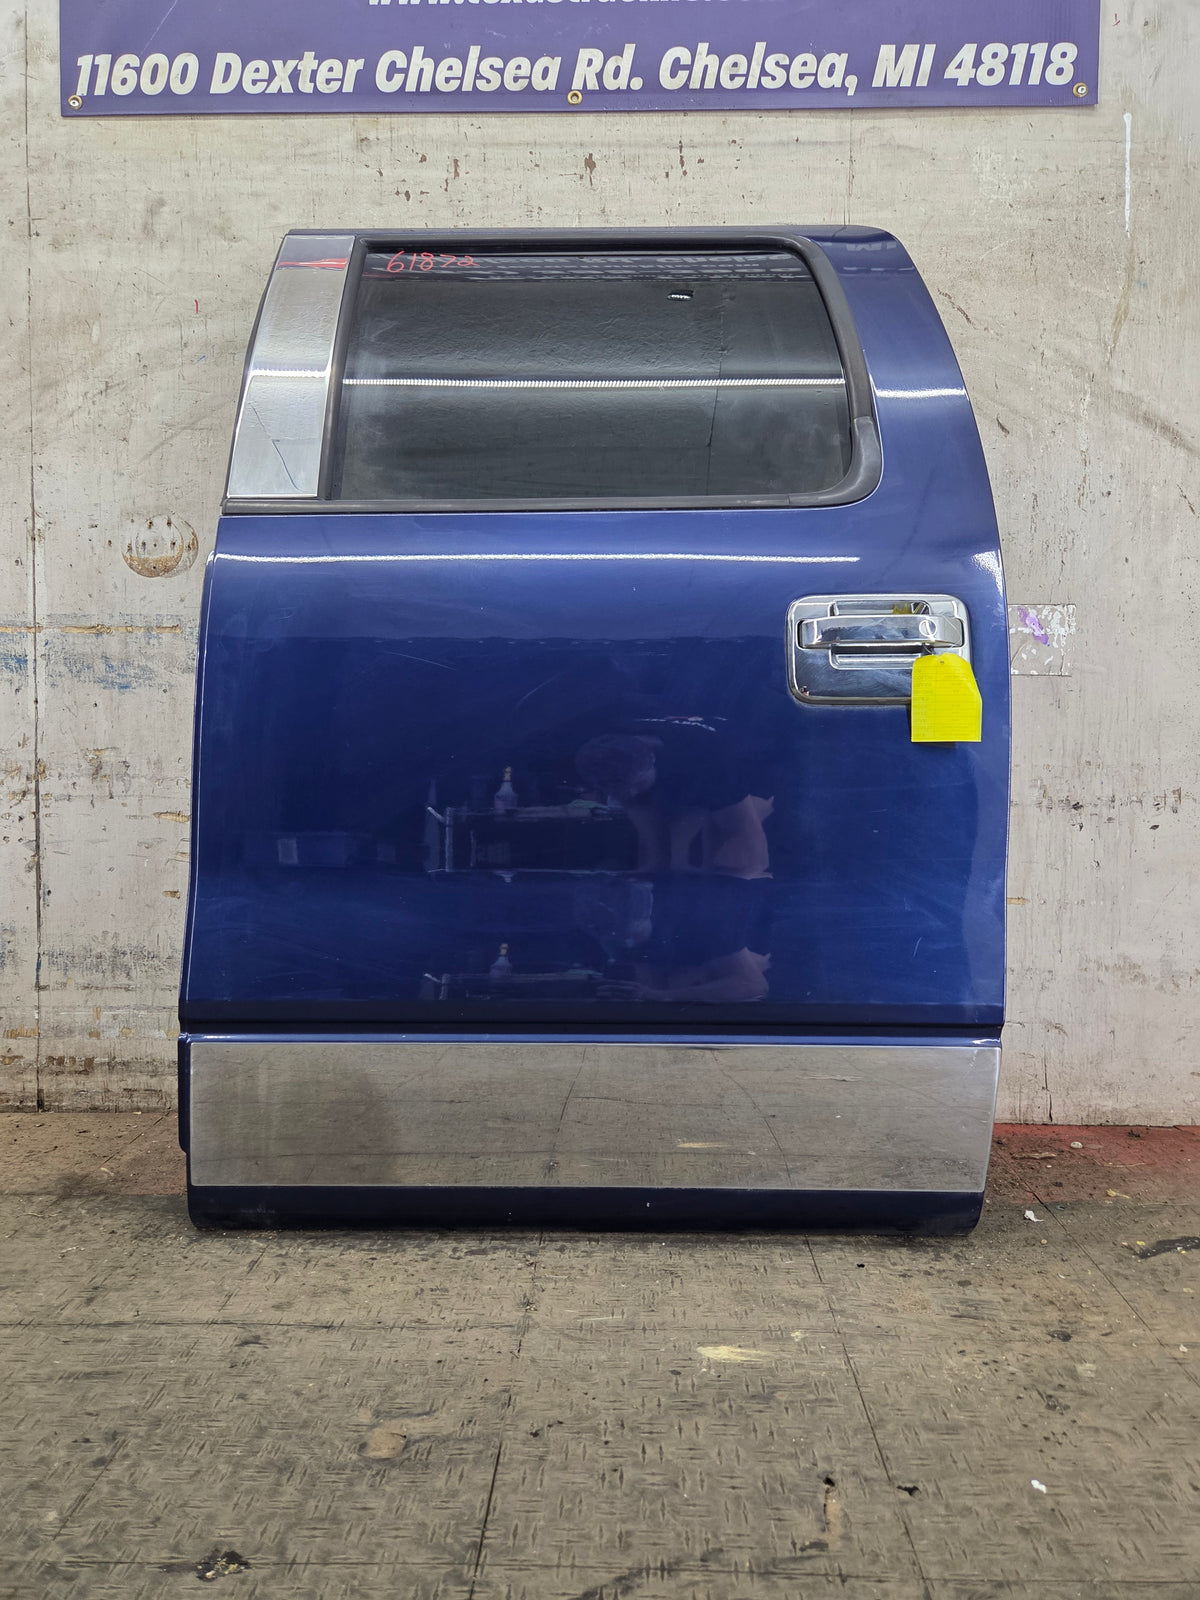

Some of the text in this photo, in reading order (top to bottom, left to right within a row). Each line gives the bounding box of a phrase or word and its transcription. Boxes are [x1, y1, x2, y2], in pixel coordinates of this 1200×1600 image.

[76, 41, 1078, 97] 11600 Dexter Chelsea Rd. Chelsea, MI 48118
[387, 251, 480, 273] 61872
